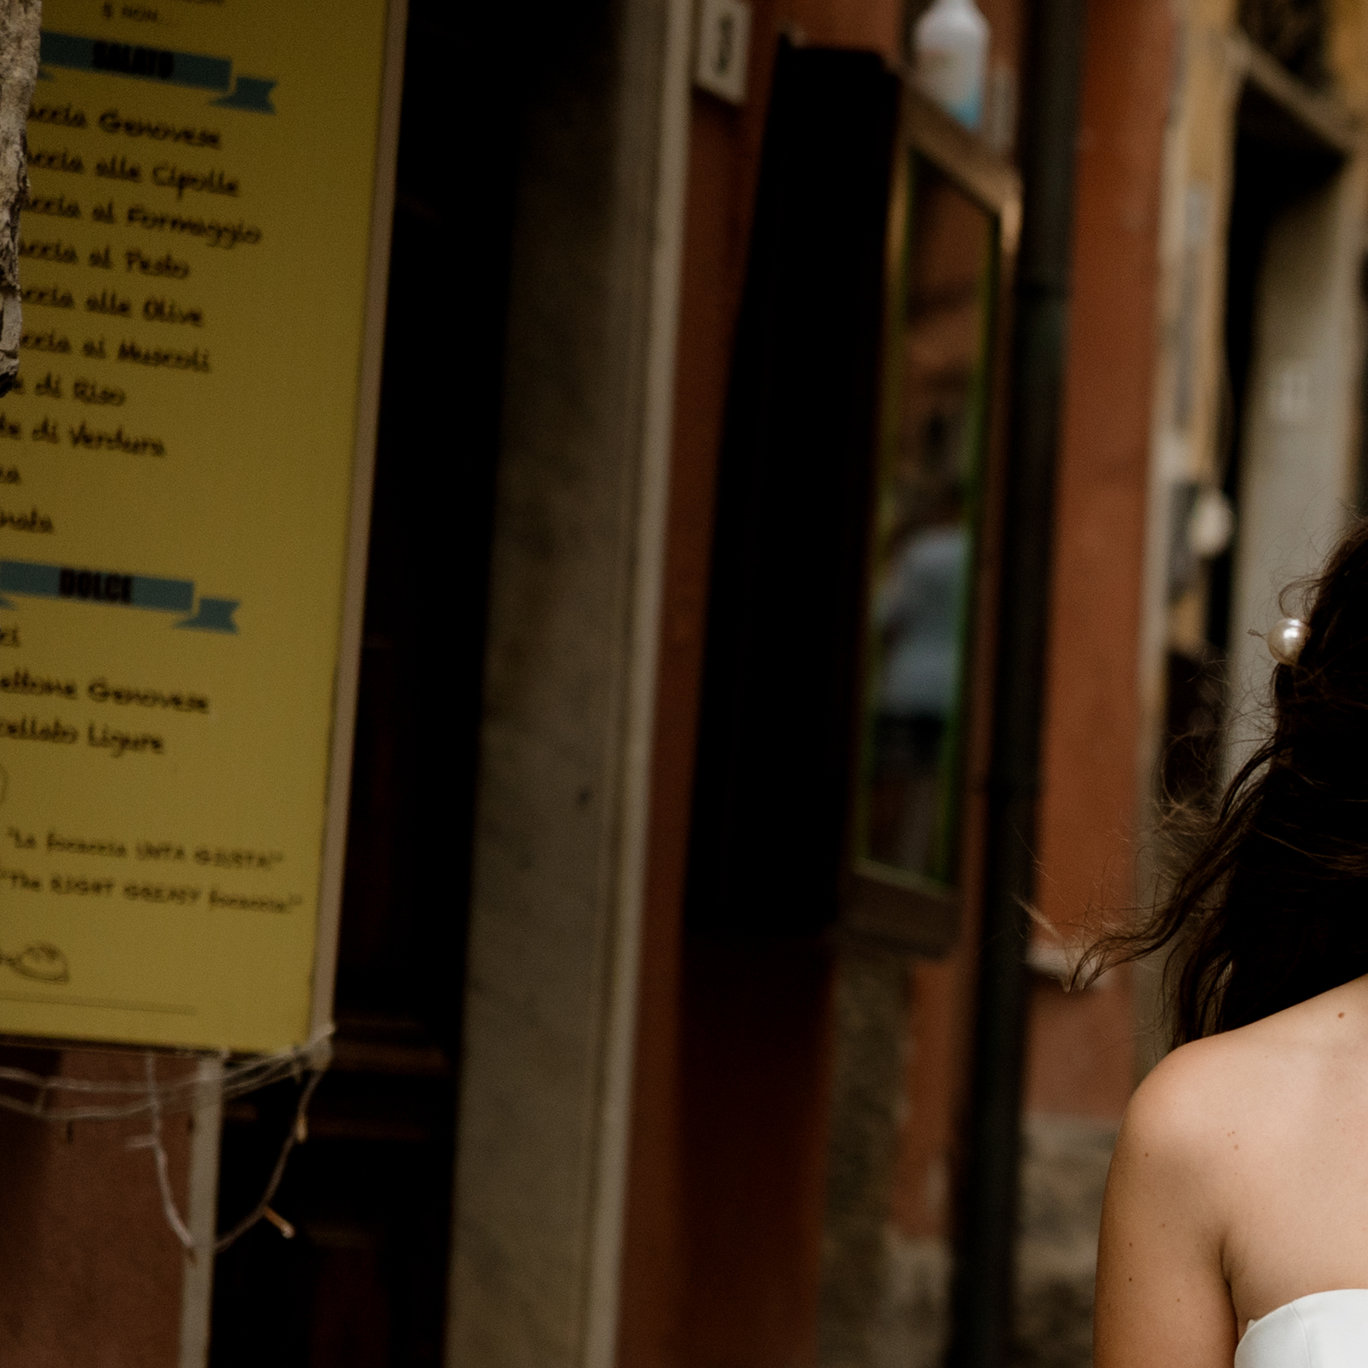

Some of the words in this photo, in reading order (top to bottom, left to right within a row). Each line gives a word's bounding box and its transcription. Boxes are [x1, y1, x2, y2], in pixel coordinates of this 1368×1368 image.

[93, 39, 174, 80] SALATO
[98, 105, 222, 149] Genovese
[96, 154, 142, 183] alle
[151, 158, 239, 200] Cipolle
[92, 199, 115, 224] al
[127, 204, 263, 250] Formaggio
[89, 243, 112, 269] al
[125, 247, 191, 280] Pesto
[85, 289, 131, 317] alle
[142, 294, 204, 328] Olive
[82, 336, 106, 360] ai
[118, 339, 211, 374] Muscoli
[35, 372, 62, 399] di
[74, 376, 126, 407] Riso
[32, 416, 58, 444] di
[69, 420, 167, 458] Verdura
[58, 566, 133, 606] DOLCE
[87, 676, 210, 715] Genovese
[88, 719, 165, 758] Ligure
